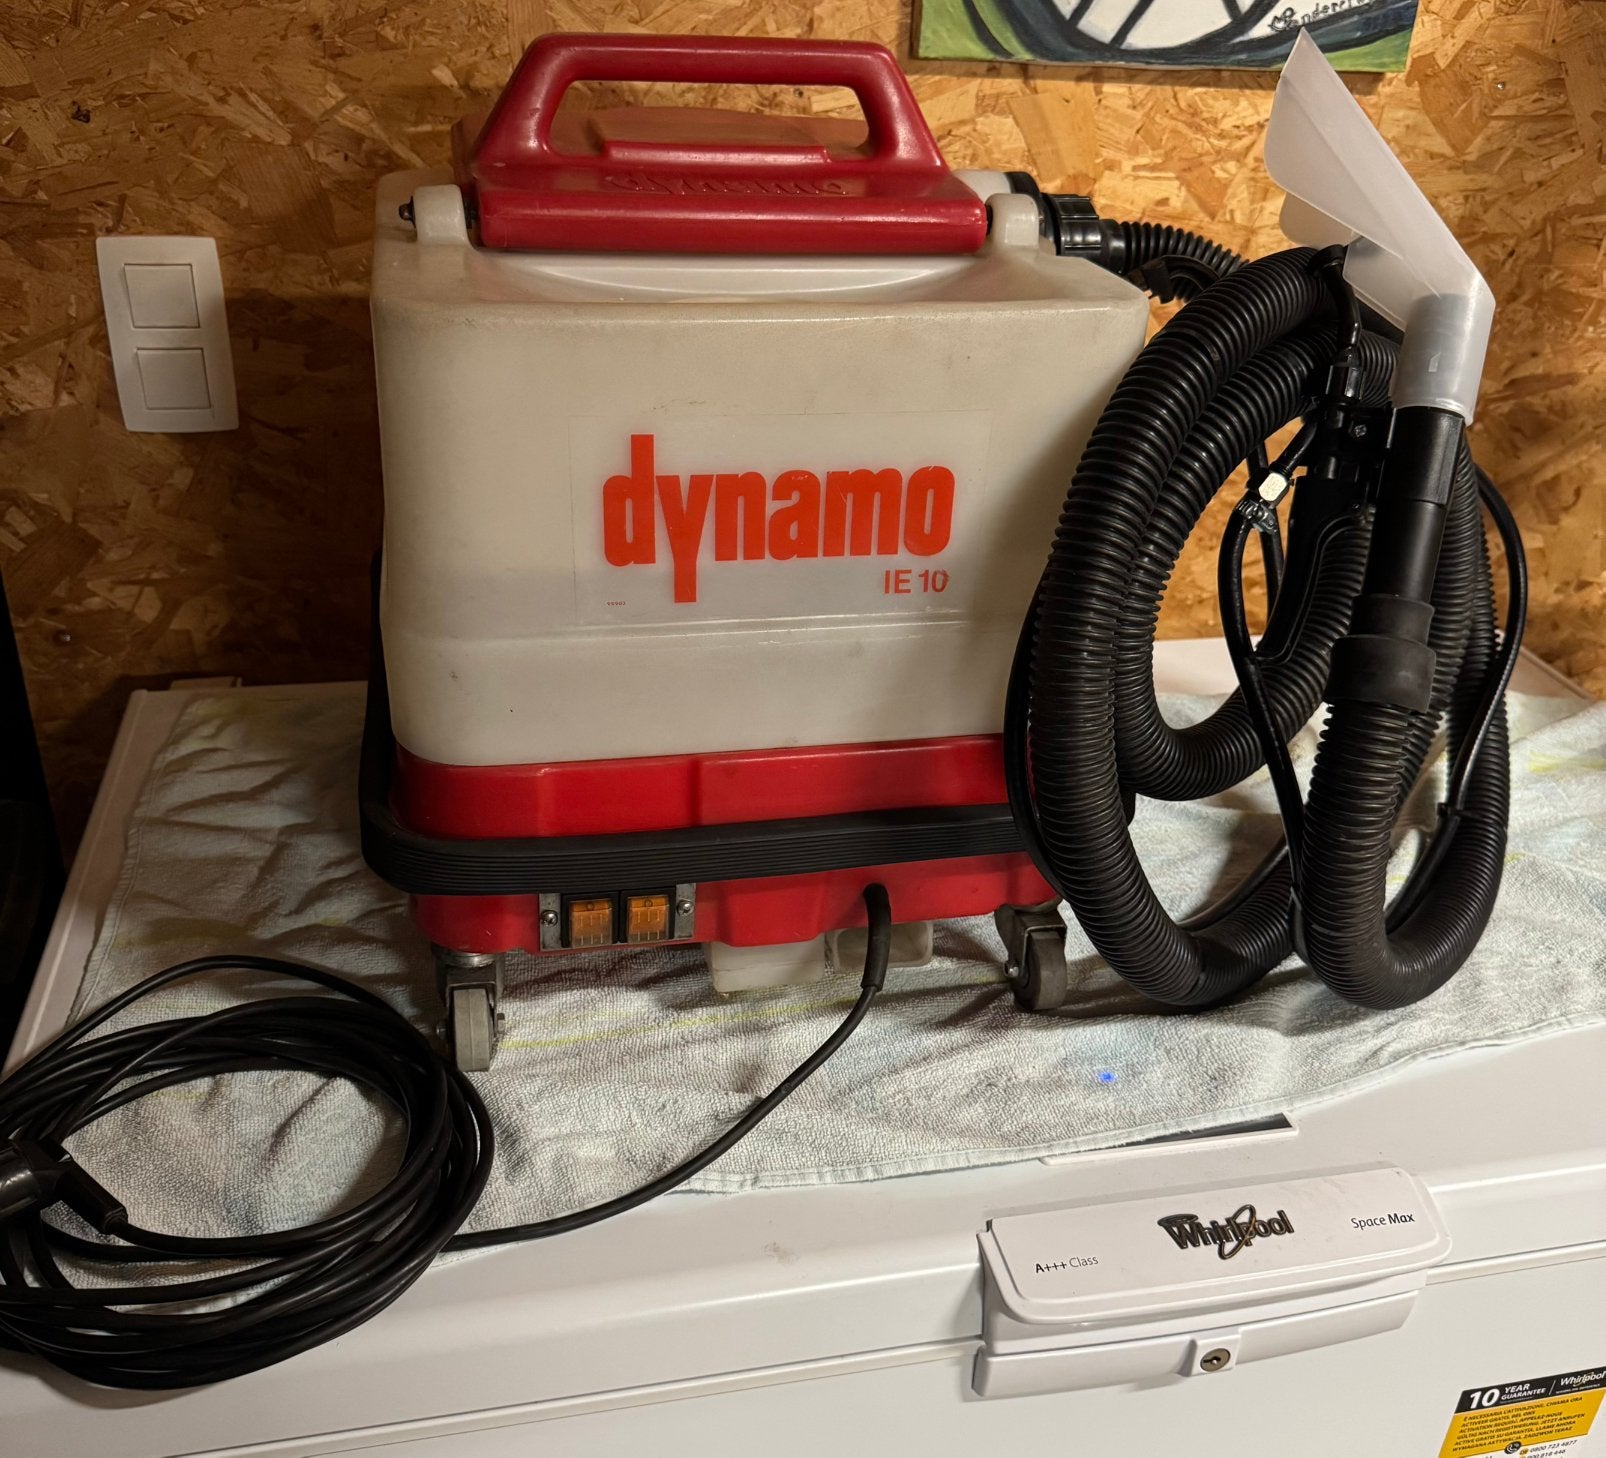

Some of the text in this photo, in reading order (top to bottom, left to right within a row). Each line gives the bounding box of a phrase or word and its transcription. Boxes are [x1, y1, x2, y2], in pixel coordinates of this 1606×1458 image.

[603, 434, 955, 603] dynamo
[884, 569, 950, 595] IE 10
[1351, 1212, 1415, 1229] Space Max
[1158, 1205, 1295, 1259] Whirlpool
[1035, 1255, 1099, 1274] A+++ Class
[1501, 1388, 1546, 1400] GUARANTEE
[1505, 1383, 1530, 1394] YEAR
[1469, 1389, 1501, 1409] 10
